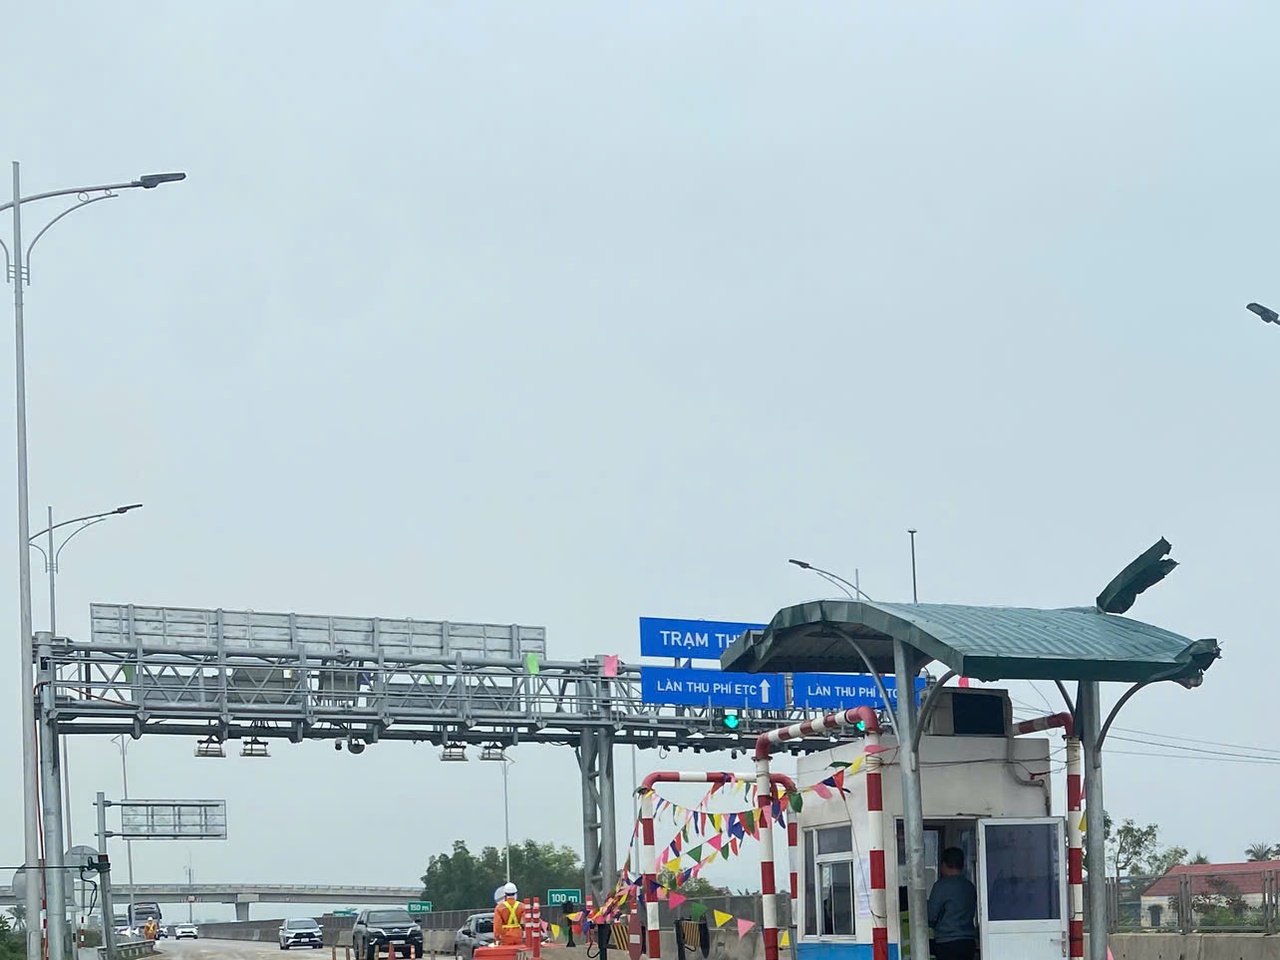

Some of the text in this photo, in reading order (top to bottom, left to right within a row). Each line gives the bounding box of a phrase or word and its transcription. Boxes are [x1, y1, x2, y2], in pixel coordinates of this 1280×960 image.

[660, 630, 741, 650] TRẠM TH
[657, 678, 757, 695] LÀN THU PHÍ ETC
[808, 682, 898, 699] LÀN THU PHÍ TC
[551, 893, 578, 903] 100 m
